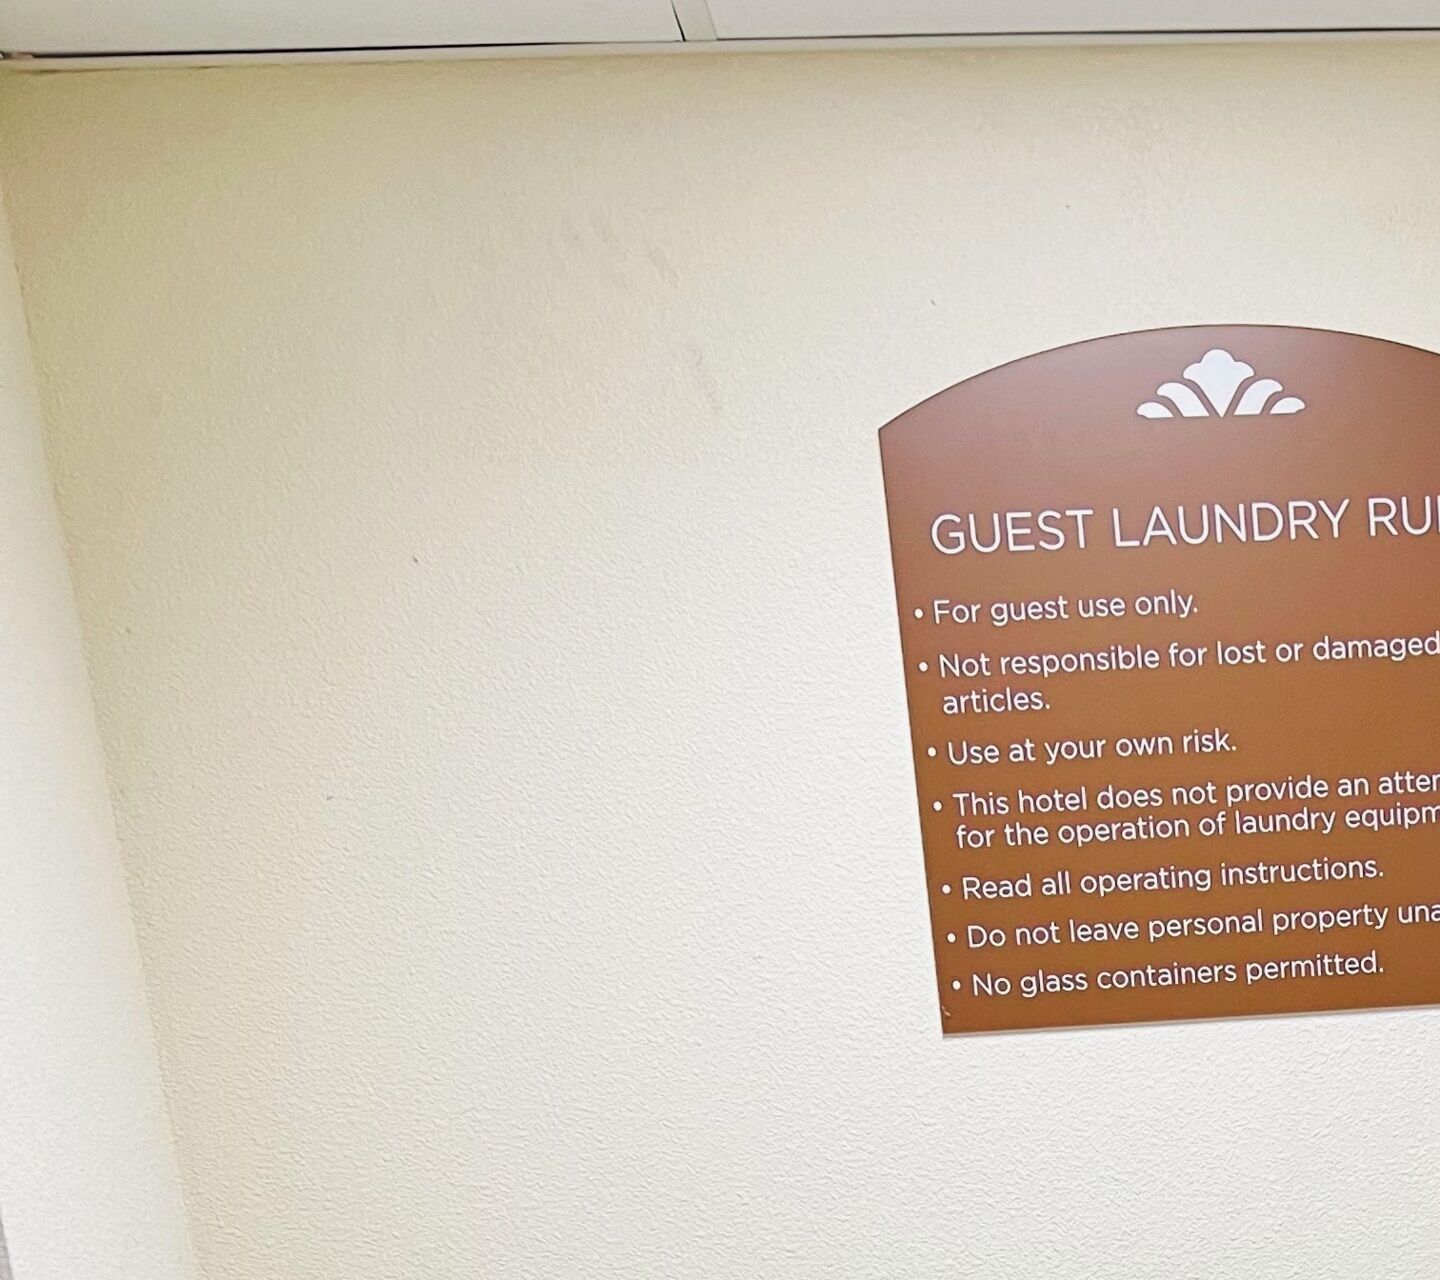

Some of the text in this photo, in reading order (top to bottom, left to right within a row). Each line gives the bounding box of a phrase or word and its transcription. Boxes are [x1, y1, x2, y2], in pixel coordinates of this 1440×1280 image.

[931, 508, 1094, 555] GUEST
[1112, 498, 1350, 548] LAUNDRY
[933, 588, 1198, 627] For guest use only.
[939, 630, 1440, 678] Not responsible for lost or damaged
[943, 686, 1050, 715] articles.
[948, 727, 1237, 765] Use at your own risk.
[952, 791, 1010, 817] This
[1018, 786, 1087, 813] hotel
[1096, 784, 1163, 810] does
[1172, 781, 1218, 806] not
[1226, 774, 1329, 808] provide
[1337, 777, 1369, 797] an
[956, 824, 995, 849] for
[1004, 821, 1049, 846] the
[1058, 815, 1190, 847] operation
[1198, 810, 1227, 836] of
[1235, 806, 1336, 834] laundry
[962, 856, 1384, 900] Read all operating instructions.
[967, 925, 1006, 948] Do
[1015, 921, 1061, 946] not
[1069, 918, 1139, 943] leave
[1148, 908, 1263, 943] personal
[1272, 904, 1389, 936] property
[972, 950, 1384, 998] No glass containers permitted.
